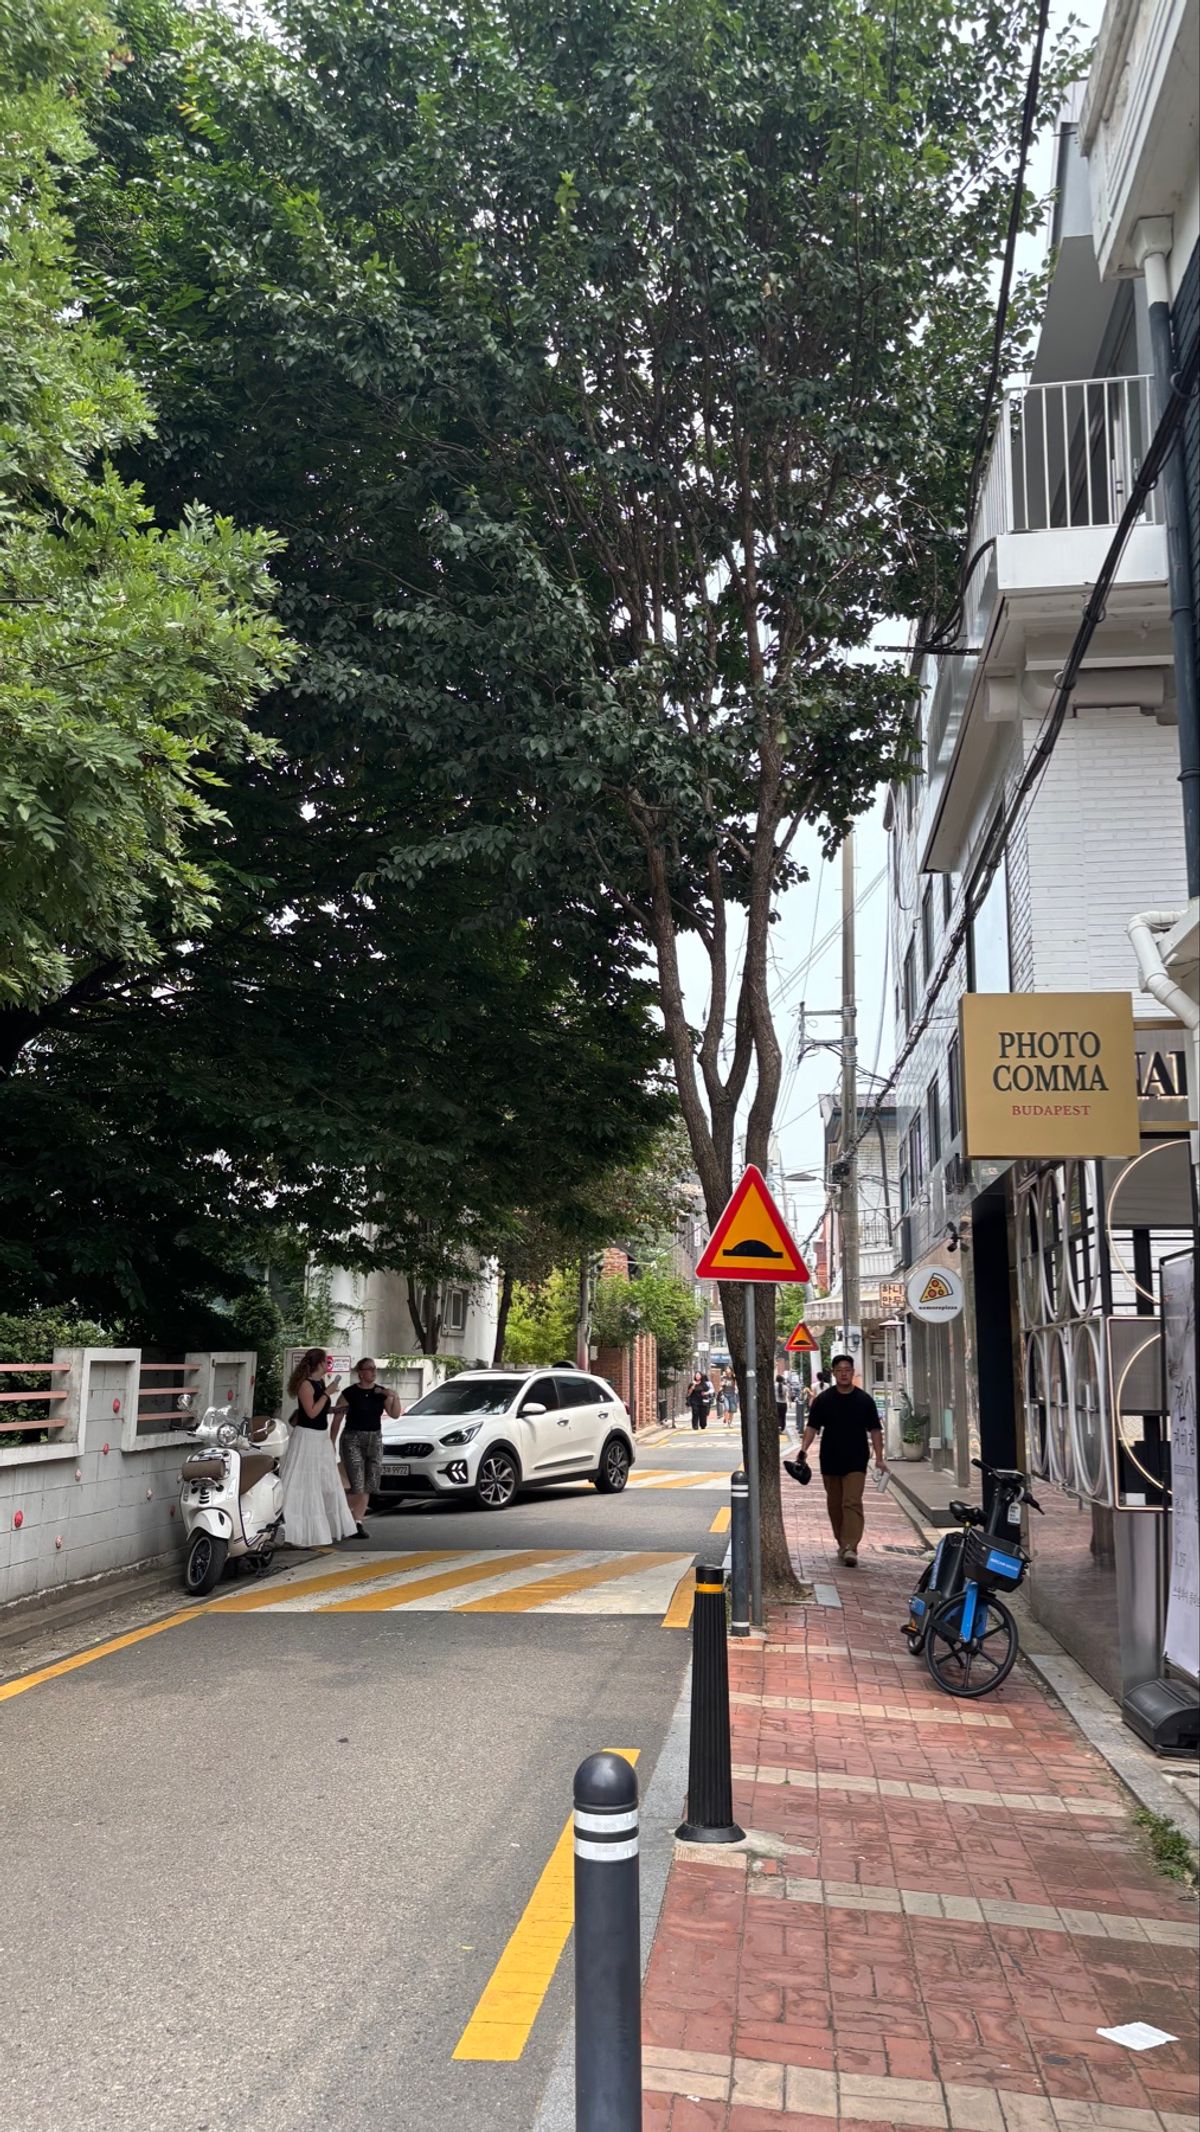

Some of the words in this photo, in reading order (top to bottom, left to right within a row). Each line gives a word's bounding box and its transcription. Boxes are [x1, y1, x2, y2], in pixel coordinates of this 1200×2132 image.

[998, 1031, 1101, 1058] PHOTO
[992, 1064, 1109, 1092] COMMA
[1012, 1105, 1091, 1116] BUDAPEST
